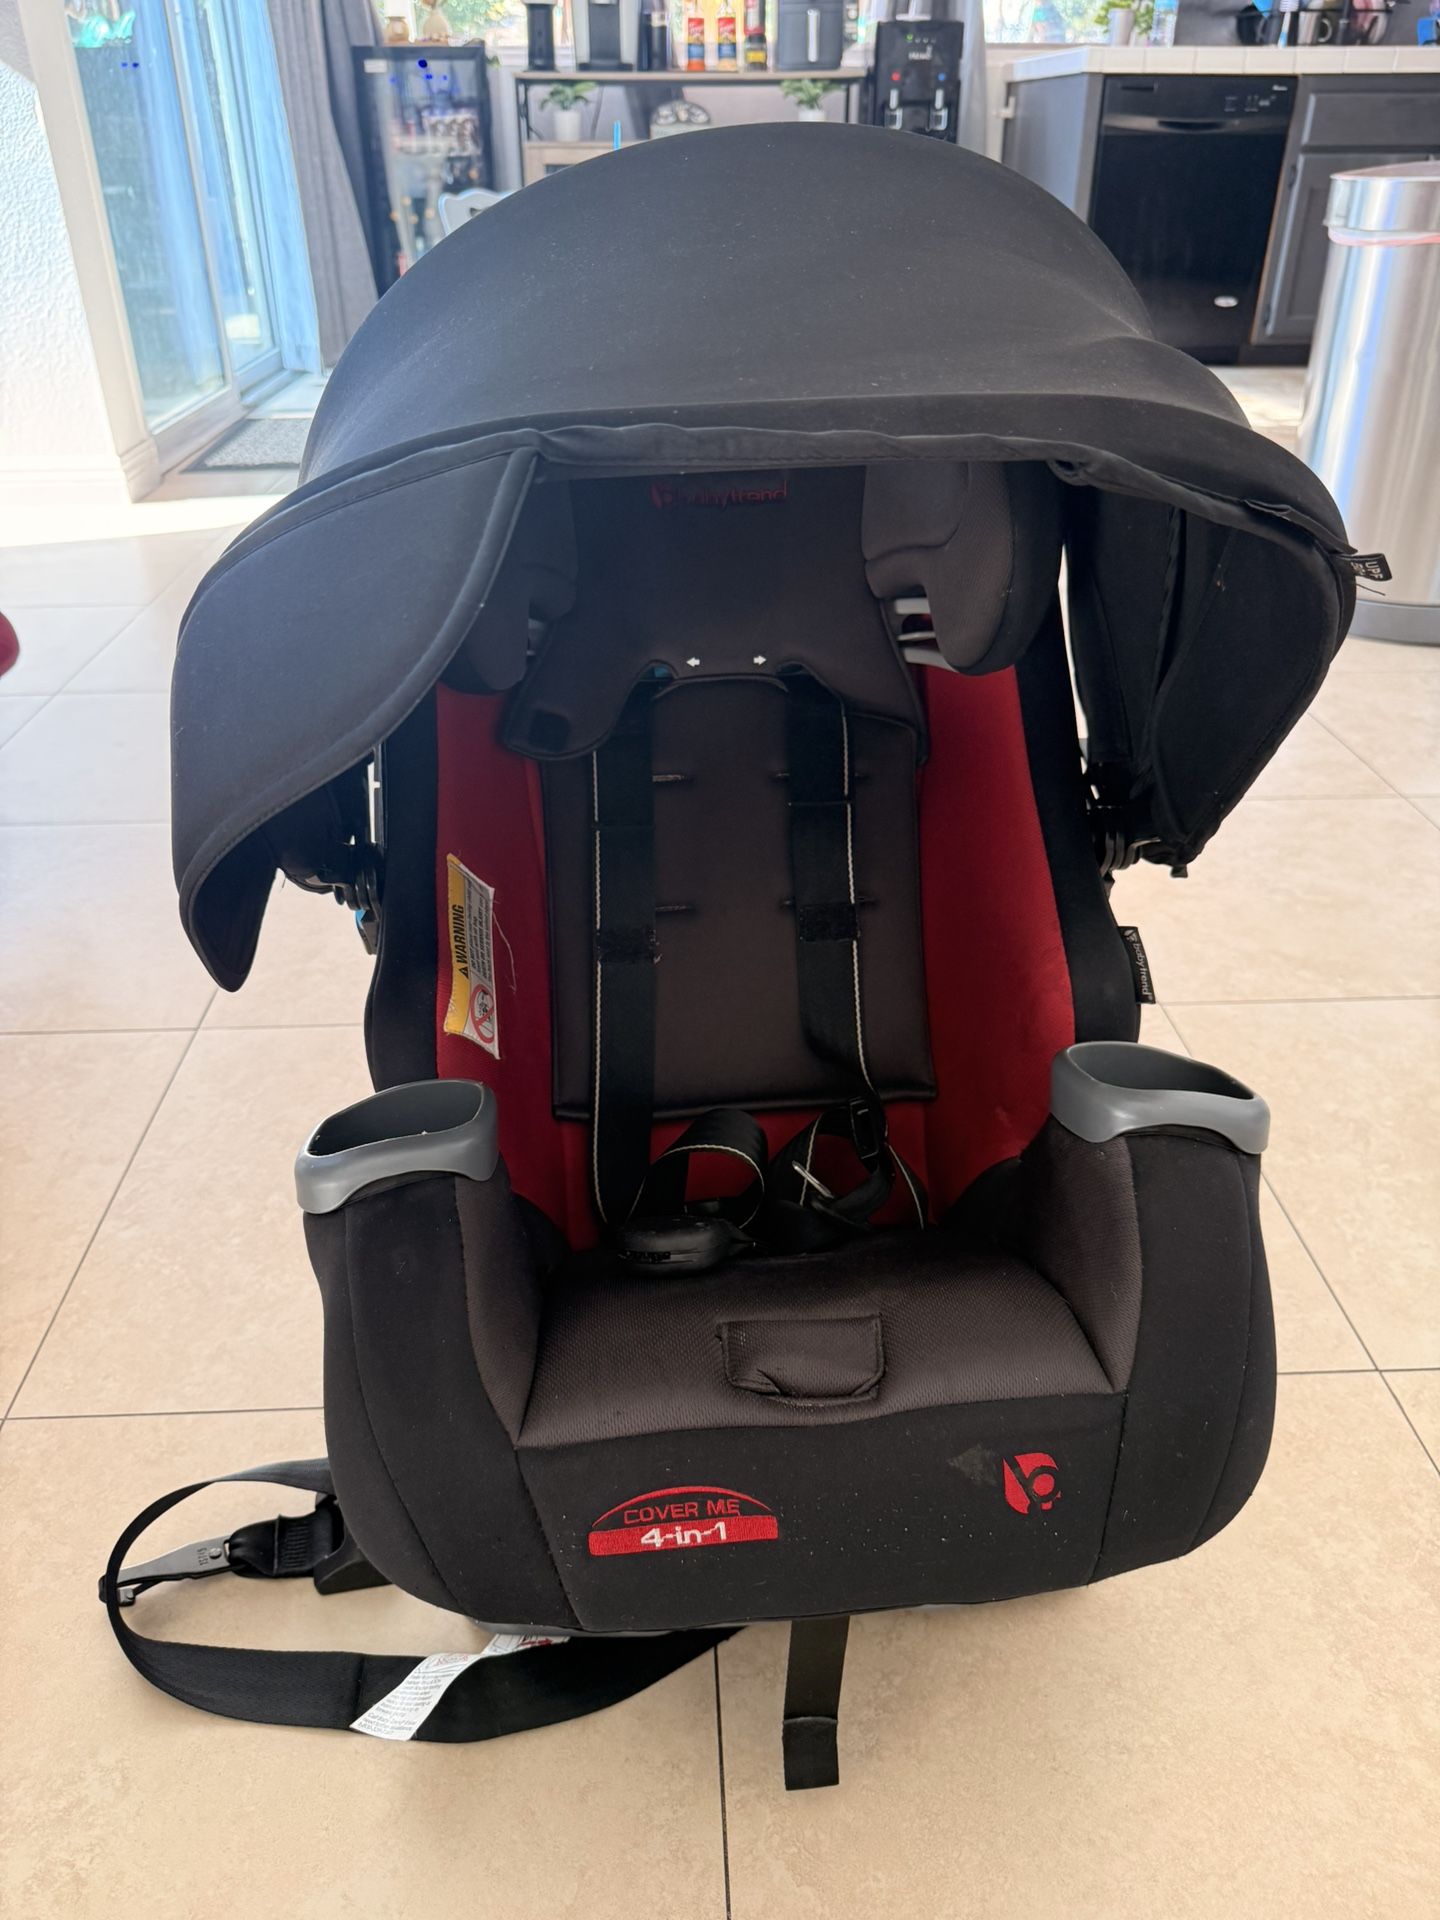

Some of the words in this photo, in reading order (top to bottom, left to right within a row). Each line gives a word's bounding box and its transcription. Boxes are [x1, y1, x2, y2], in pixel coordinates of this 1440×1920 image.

[1365, 561, 1384, 579] UPF
[452, 904, 468, 964] WARNING
[623, 1502, 699, 1525] COVER
[706, 1499, 740, 1516] ME
[640, 1521, 727, 1548] 4-in-1
